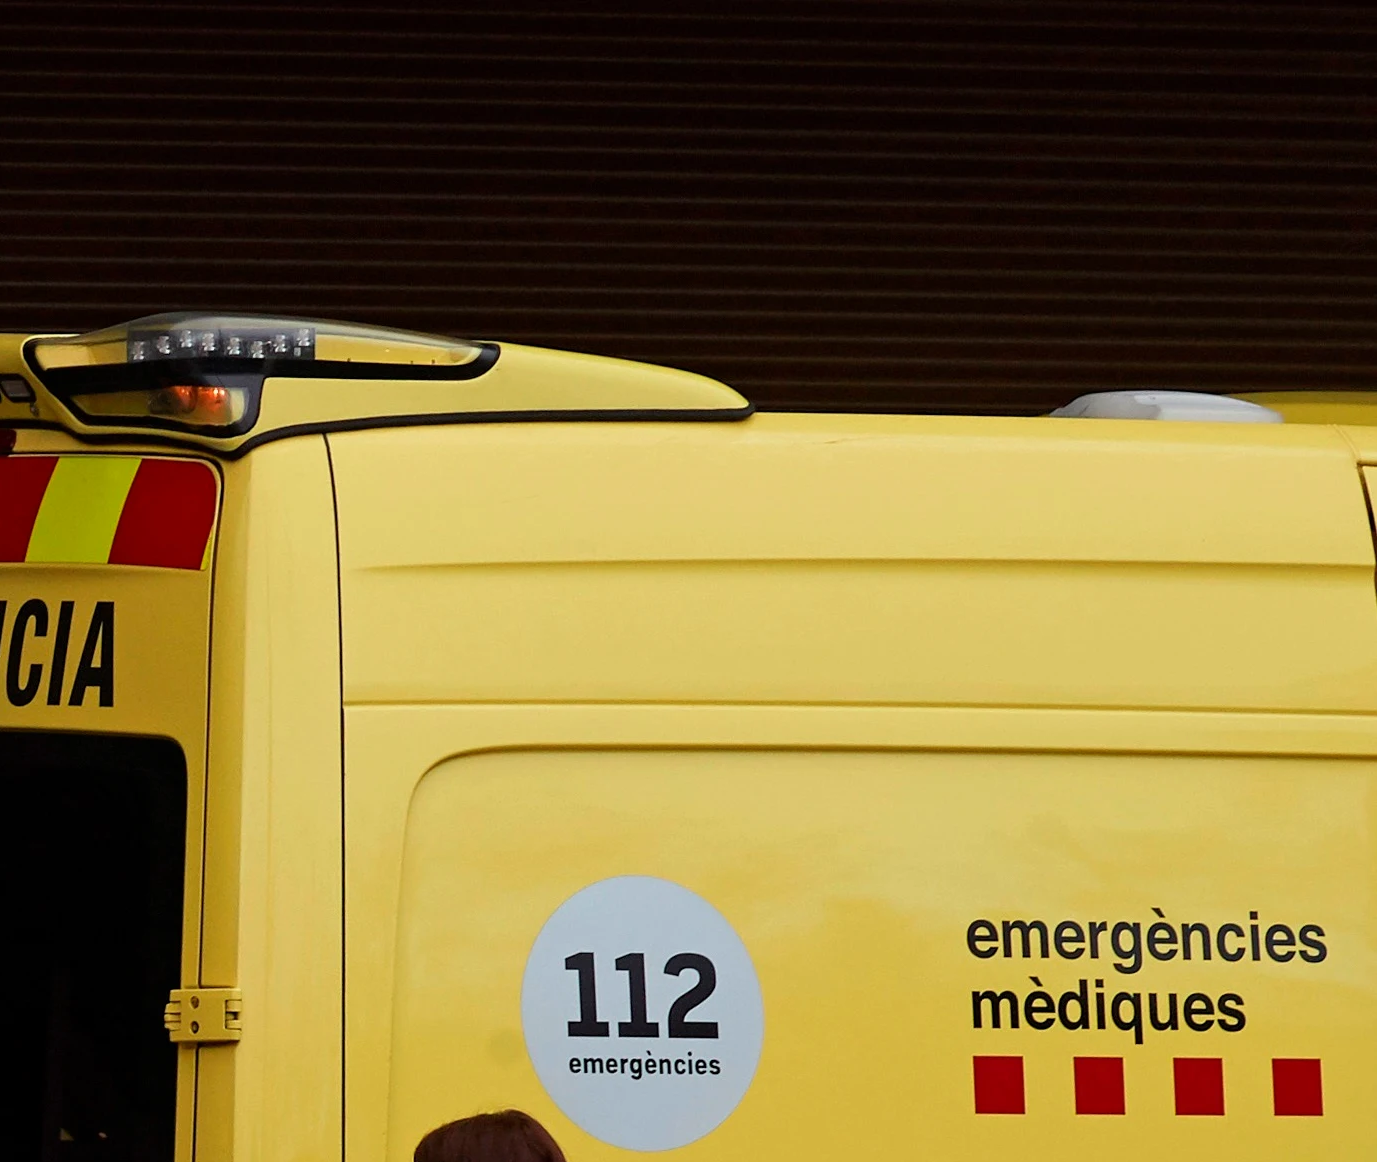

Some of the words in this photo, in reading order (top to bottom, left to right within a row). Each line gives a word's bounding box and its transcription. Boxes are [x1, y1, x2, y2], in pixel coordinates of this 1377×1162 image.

[966, 908, 1328, 974] emergències
[564, 952, 720, 1039] 112
[971, 977, 1246, 1044] mèdiques
[569, 1050, 721, 1080] emergències
